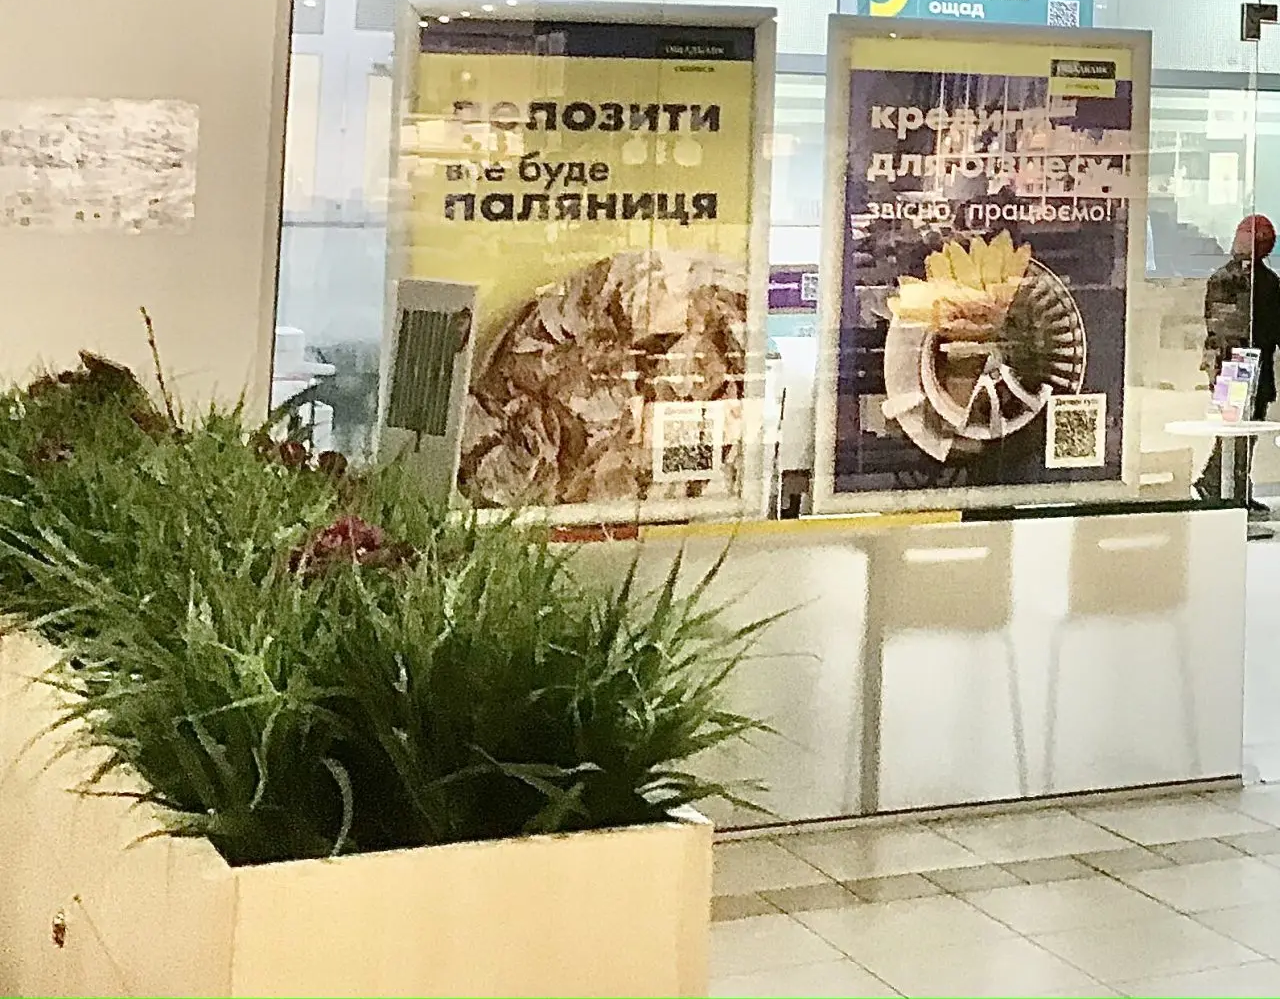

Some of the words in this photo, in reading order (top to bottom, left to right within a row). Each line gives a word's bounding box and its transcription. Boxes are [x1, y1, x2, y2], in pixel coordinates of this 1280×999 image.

[928, 0, 985, 19] ощад
[445, 162, 505, 182] ве
[518, 150, 610, 190] буде
[444, 192, 719, 227] паляниця
